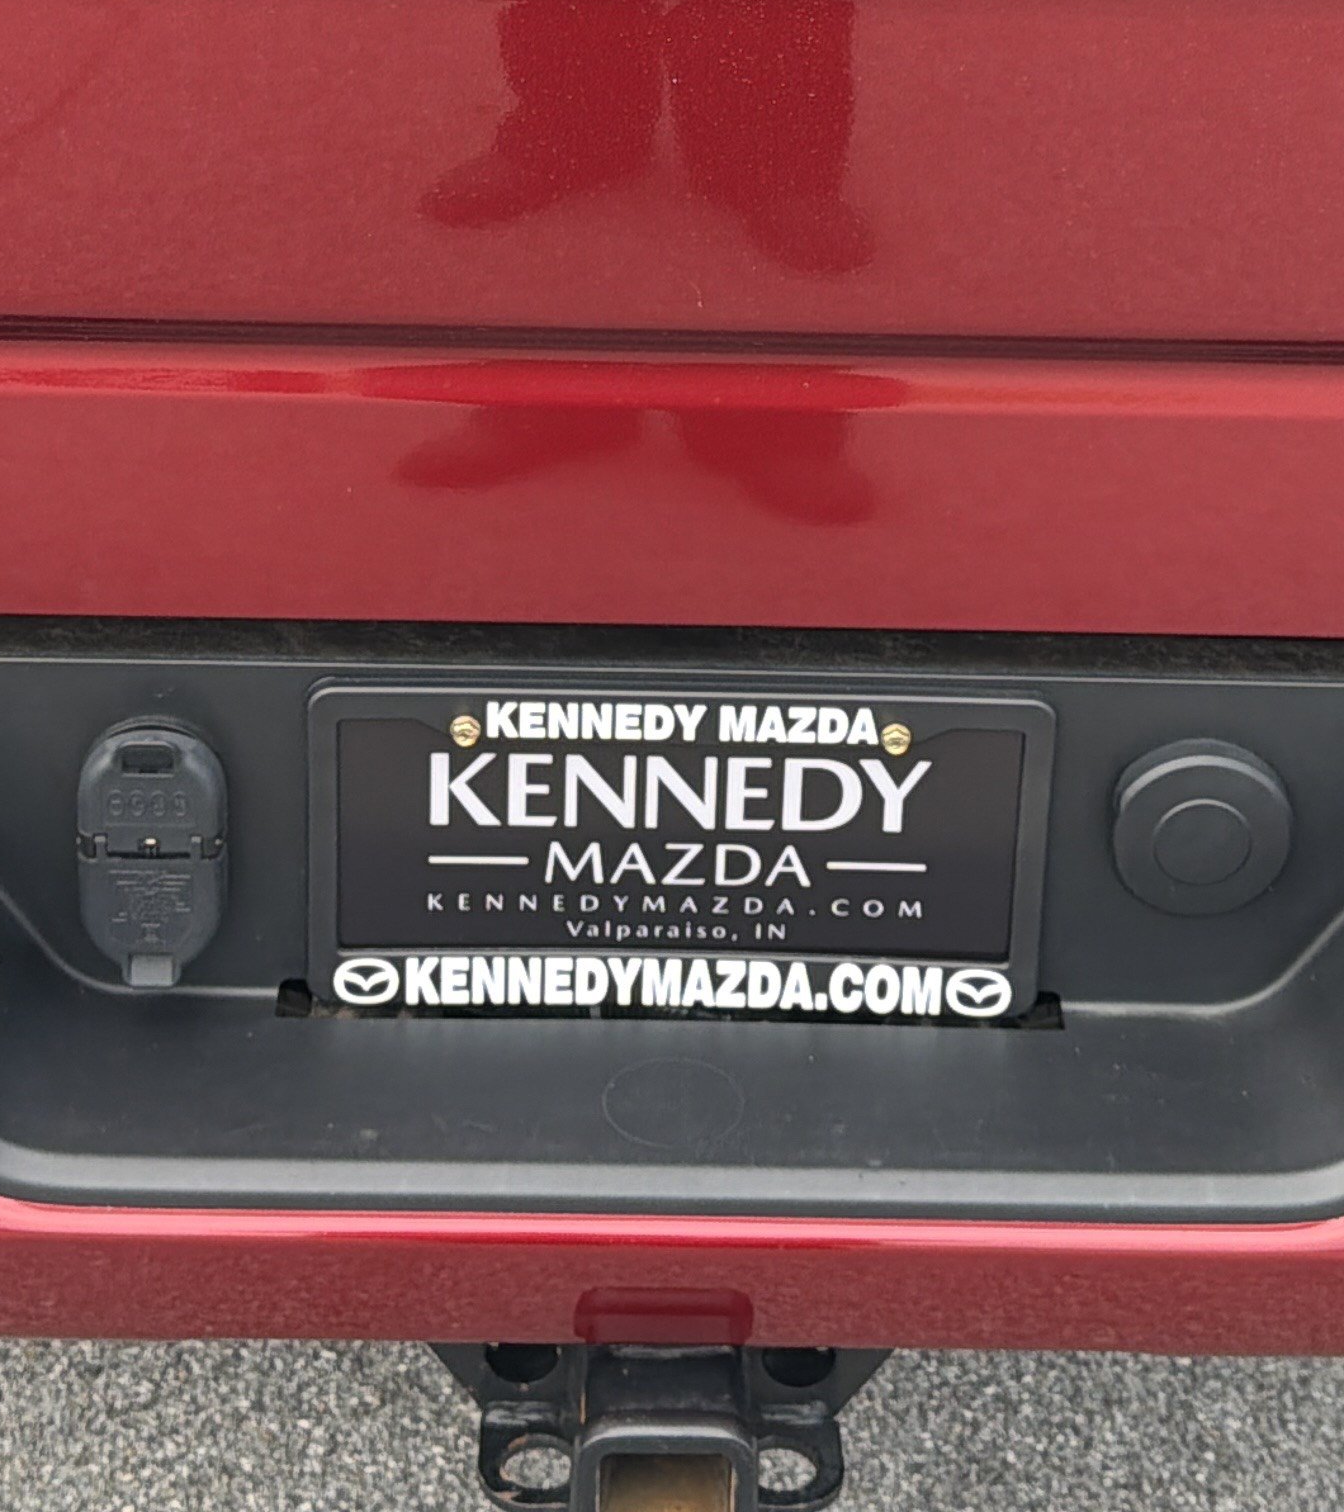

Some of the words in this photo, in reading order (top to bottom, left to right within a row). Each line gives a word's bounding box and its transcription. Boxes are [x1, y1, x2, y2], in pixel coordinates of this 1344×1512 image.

[485, 700, 708, 743] KENNEDY
[718, 705, 880, 746] MAZDA
[428, 751, 933, 834] KENNEDY
[543, 839, 812, 888] MAZDA
[426, 892, 924, 919] KENNEDYMAZDA.COM
[565, 919, 739, 943] Valparaiso,
[753, 922, 788, 941] IN
[404, 956, 945, 1017] KENNEDYMAZDA.COM
